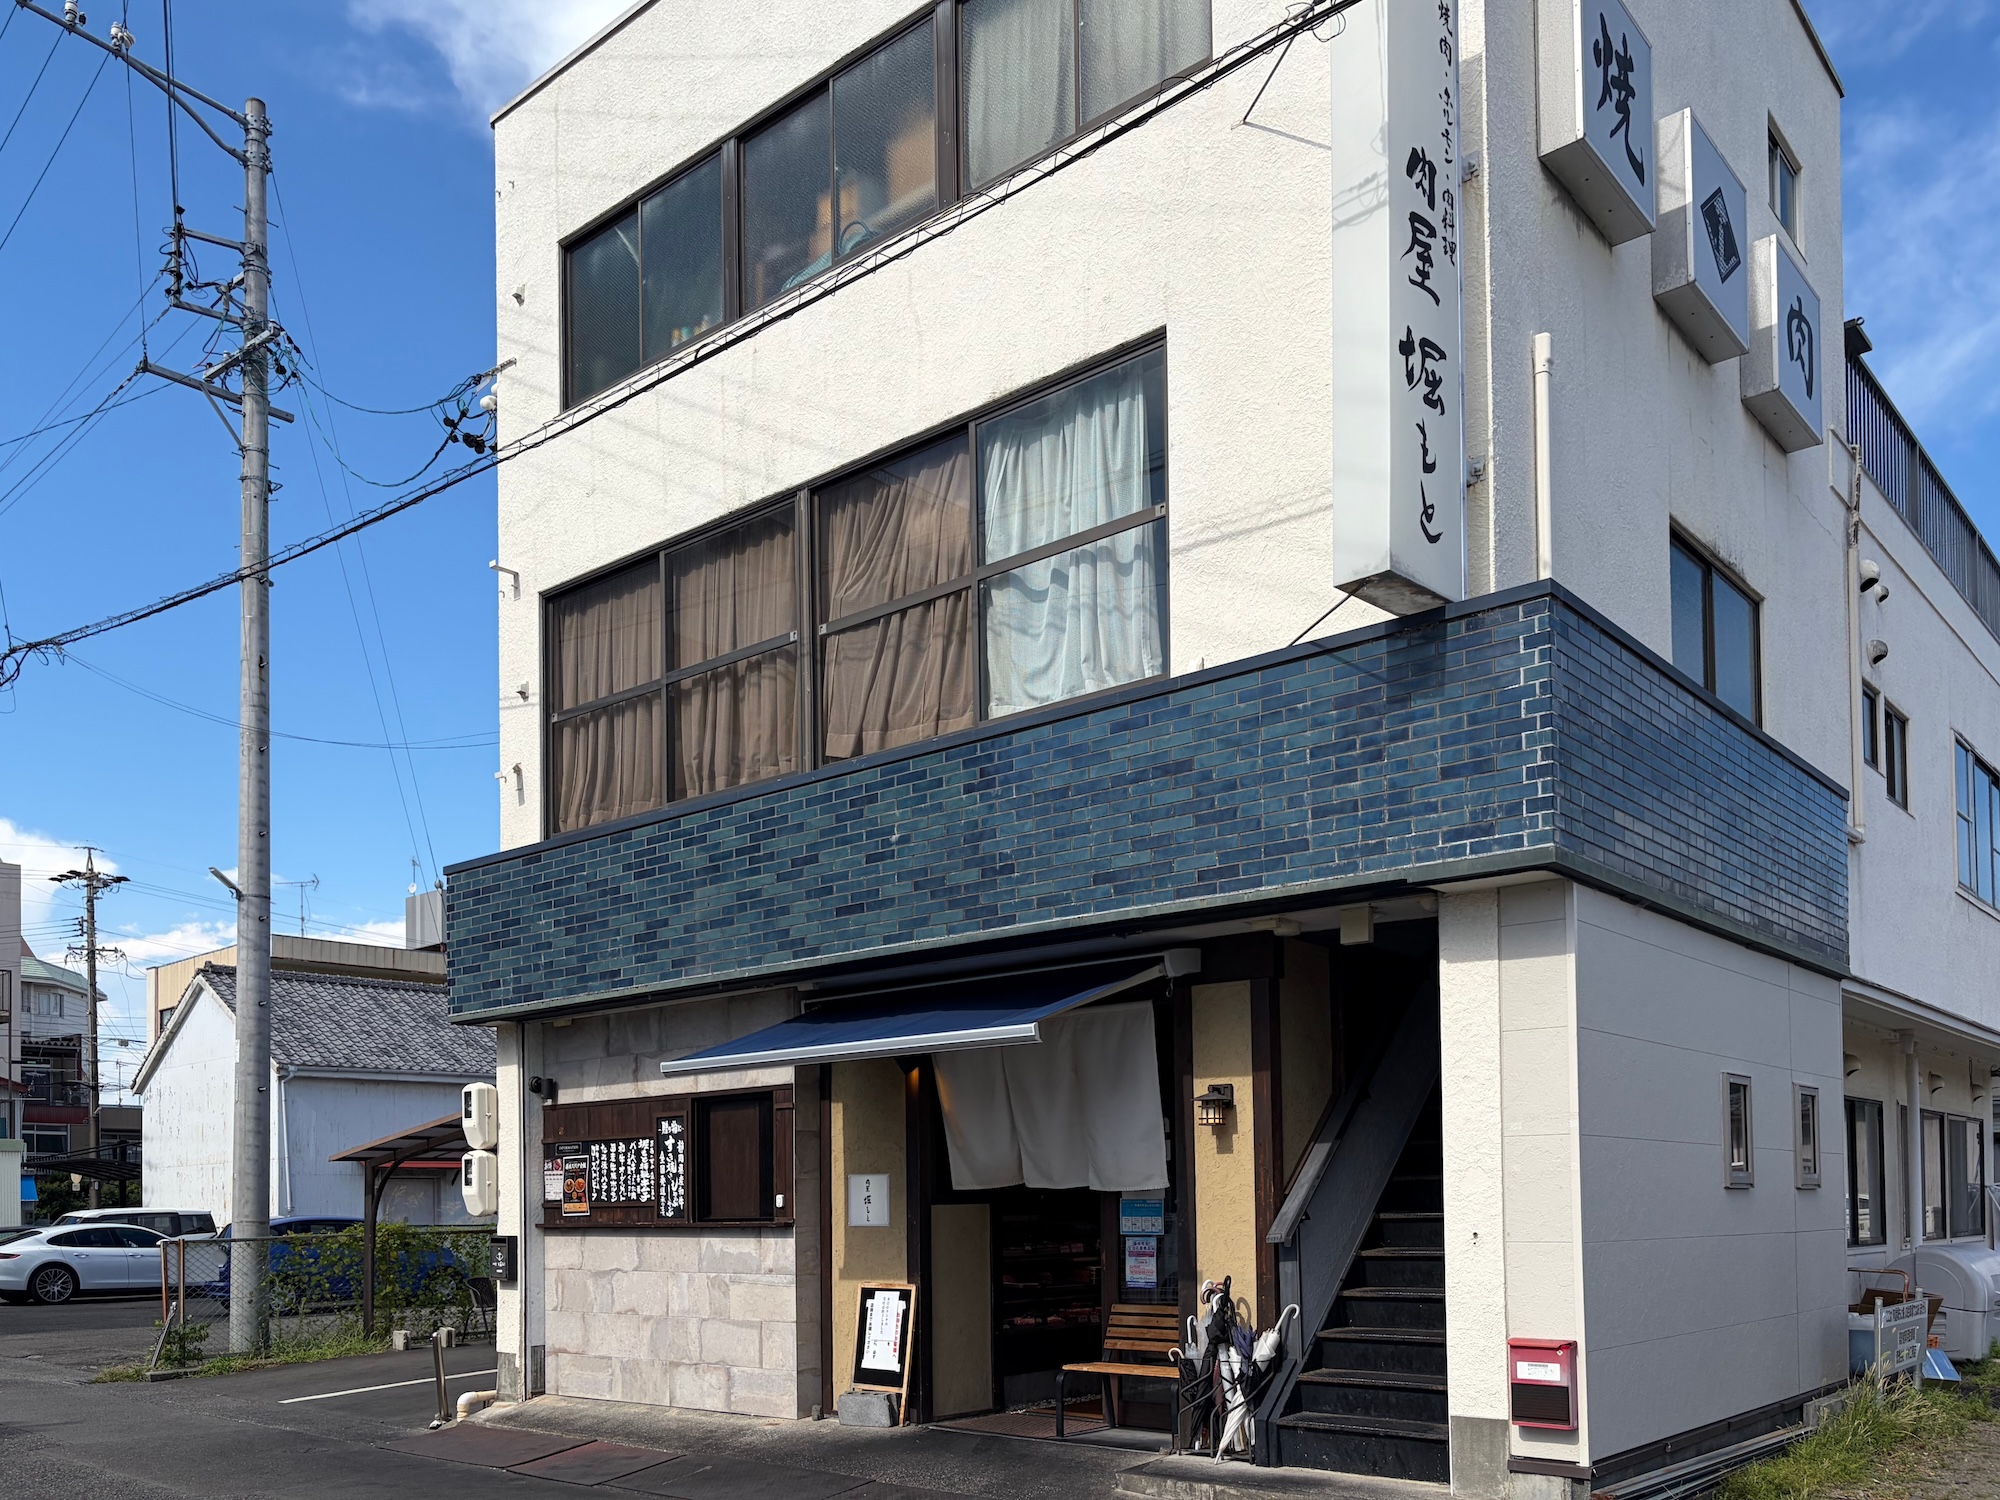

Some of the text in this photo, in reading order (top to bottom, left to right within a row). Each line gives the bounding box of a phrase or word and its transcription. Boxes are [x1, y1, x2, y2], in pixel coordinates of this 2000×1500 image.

[1592, 12, 1645, 187] 焼
[1398, 145, 1447, 544] 肉屋 堀もと
[1786, 296, 1814, 401] 肉
